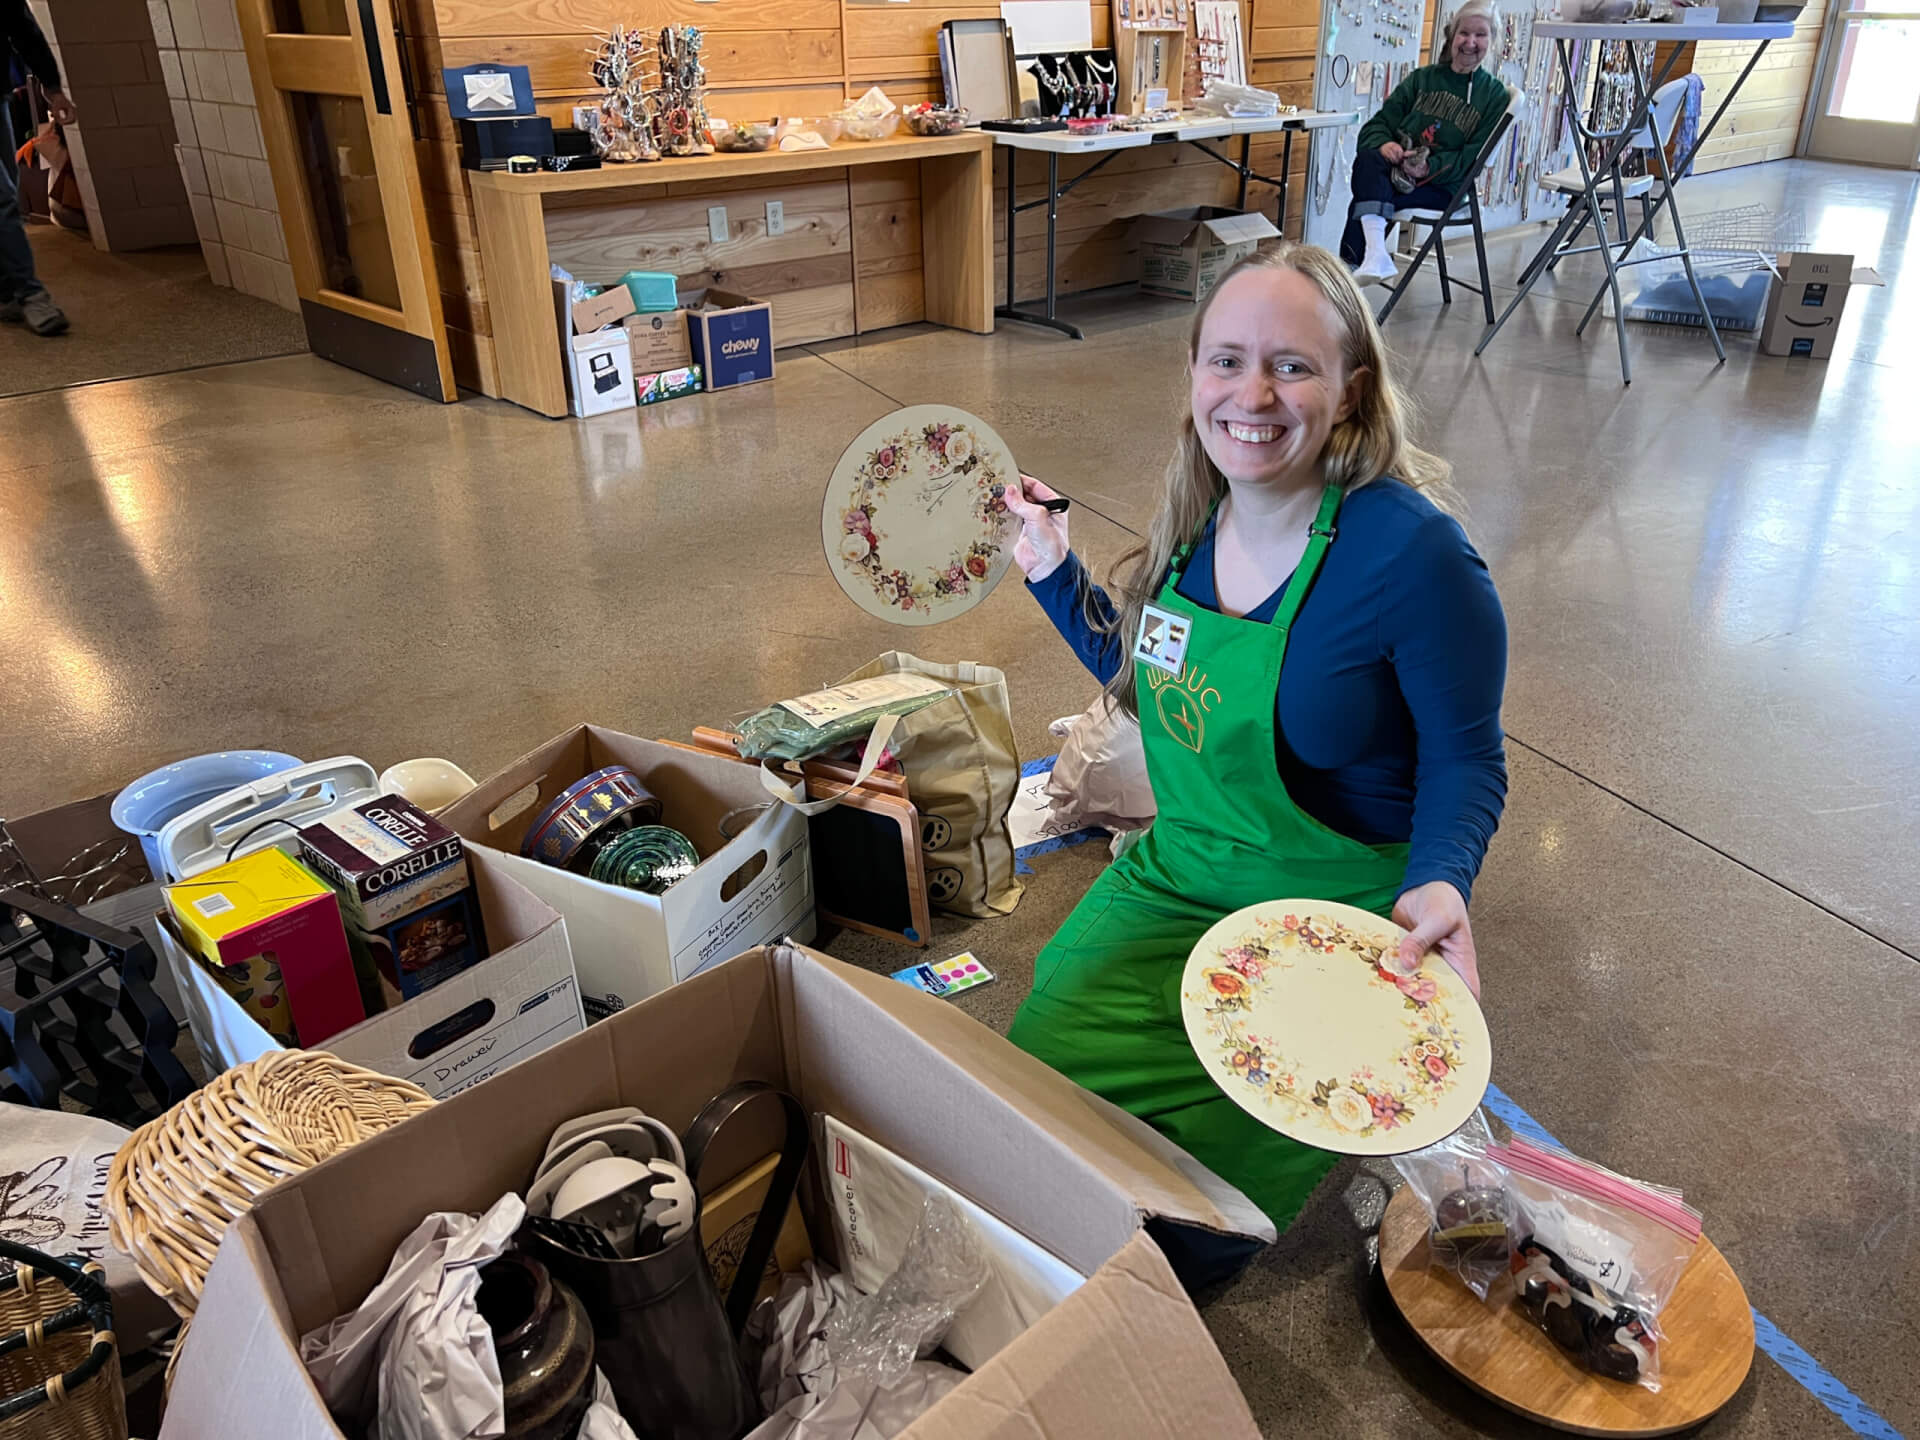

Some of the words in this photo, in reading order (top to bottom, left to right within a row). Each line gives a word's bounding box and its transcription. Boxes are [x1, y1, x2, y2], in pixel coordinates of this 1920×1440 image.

[721, 337, 760, 355] chewy
[365, 808, 429, 847] CORELLE
[365, 840, 460, 893] CORELLE
[433, 1037, 498, 1082] Drawer
